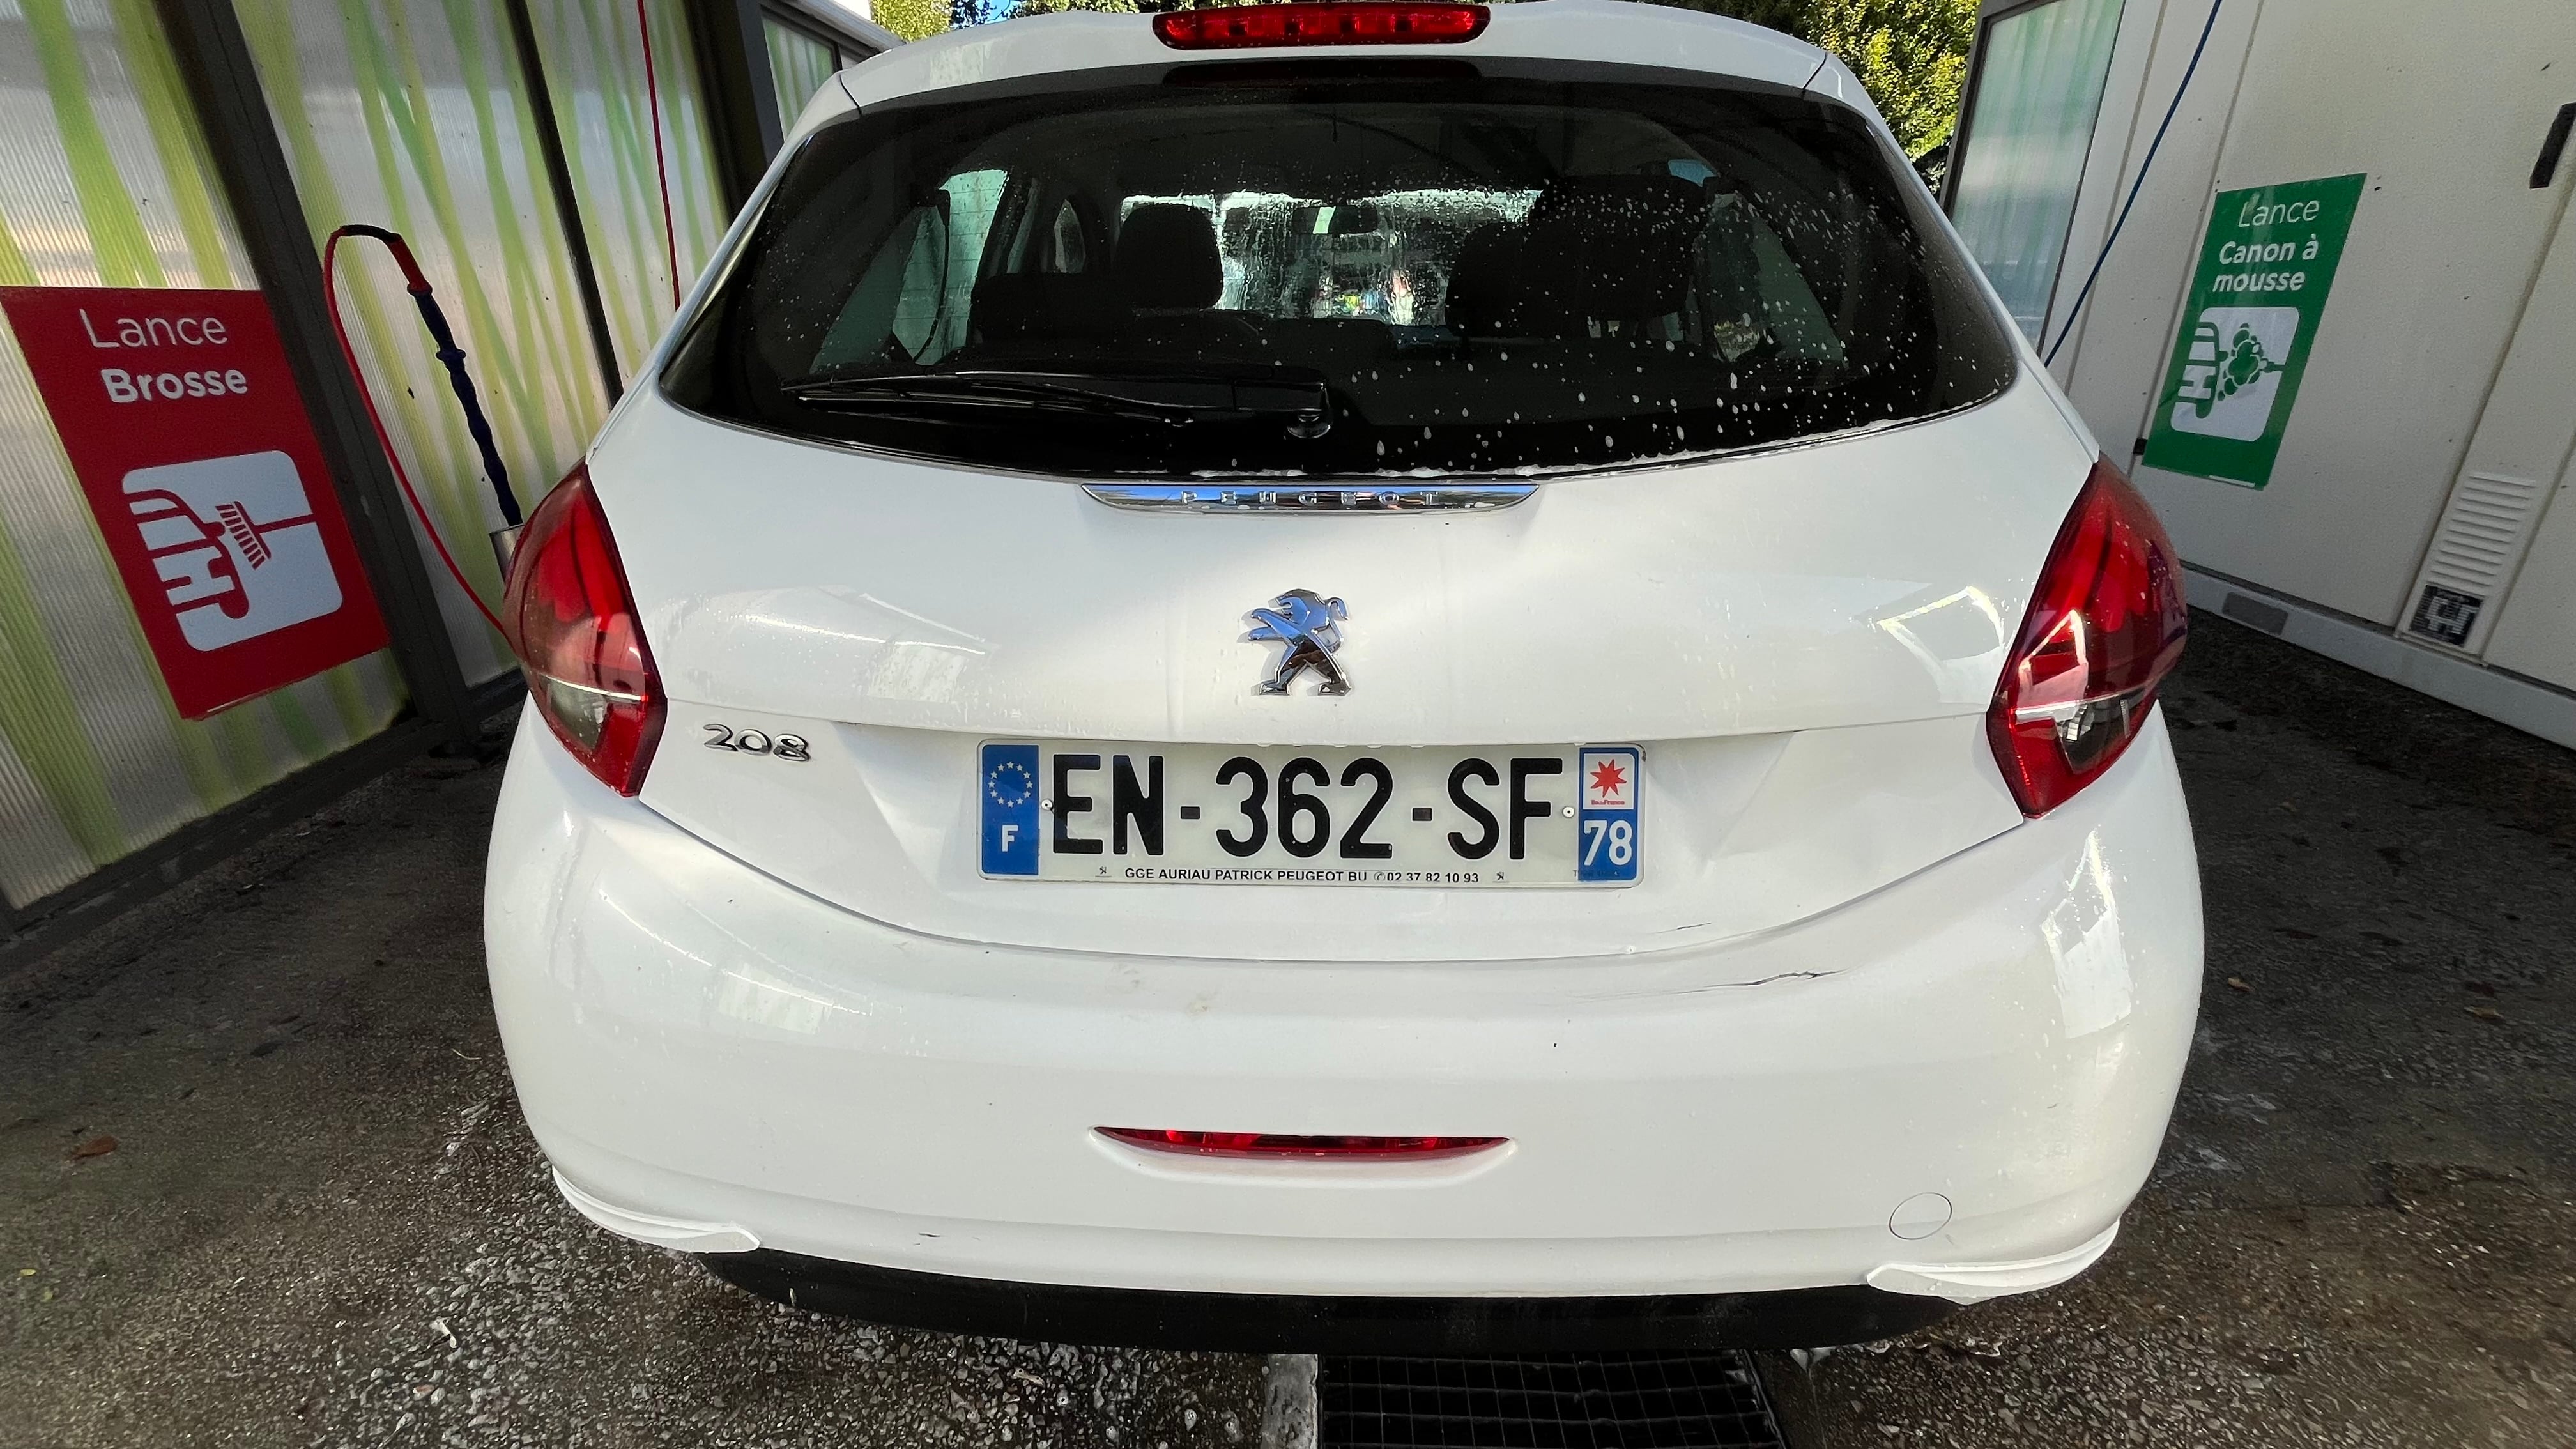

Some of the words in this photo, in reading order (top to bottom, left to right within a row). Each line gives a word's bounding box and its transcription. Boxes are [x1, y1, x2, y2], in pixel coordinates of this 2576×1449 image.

[2238, 201, 2320, 227] Lance
[2219, 241, 2296, 264] Canon
[2302, 233, 2319, 260] à
[2212, 272, 2306, 293] mousse
[79, 308, 228, 348] Lance
[100, 368, 248, 403] Brosse
[1181, 490, 1439, 505] PEUGEOT
[703, 723, 811, 762] 208
[1054, 754, 1563, 860] EN-362-SF
[1002, 824, 1018, 852] F
[1583, 820, 1632, 866] 78
[1124, 868, 1154, 879] GGE
[1158, 868, 1211, 880] AURIAU
[1215, 870, 1273, 880] PATRICK
[1277, 871, 1344, 881] PEUGEOT
[1348, 871, 1367, 881] BU
[1406, 872, 1421, 882] 37
[1425, 872, 1441, 882] 82
[1445, 872, 1459, 883] 10
[1463, 873, 1479, 883] 93
